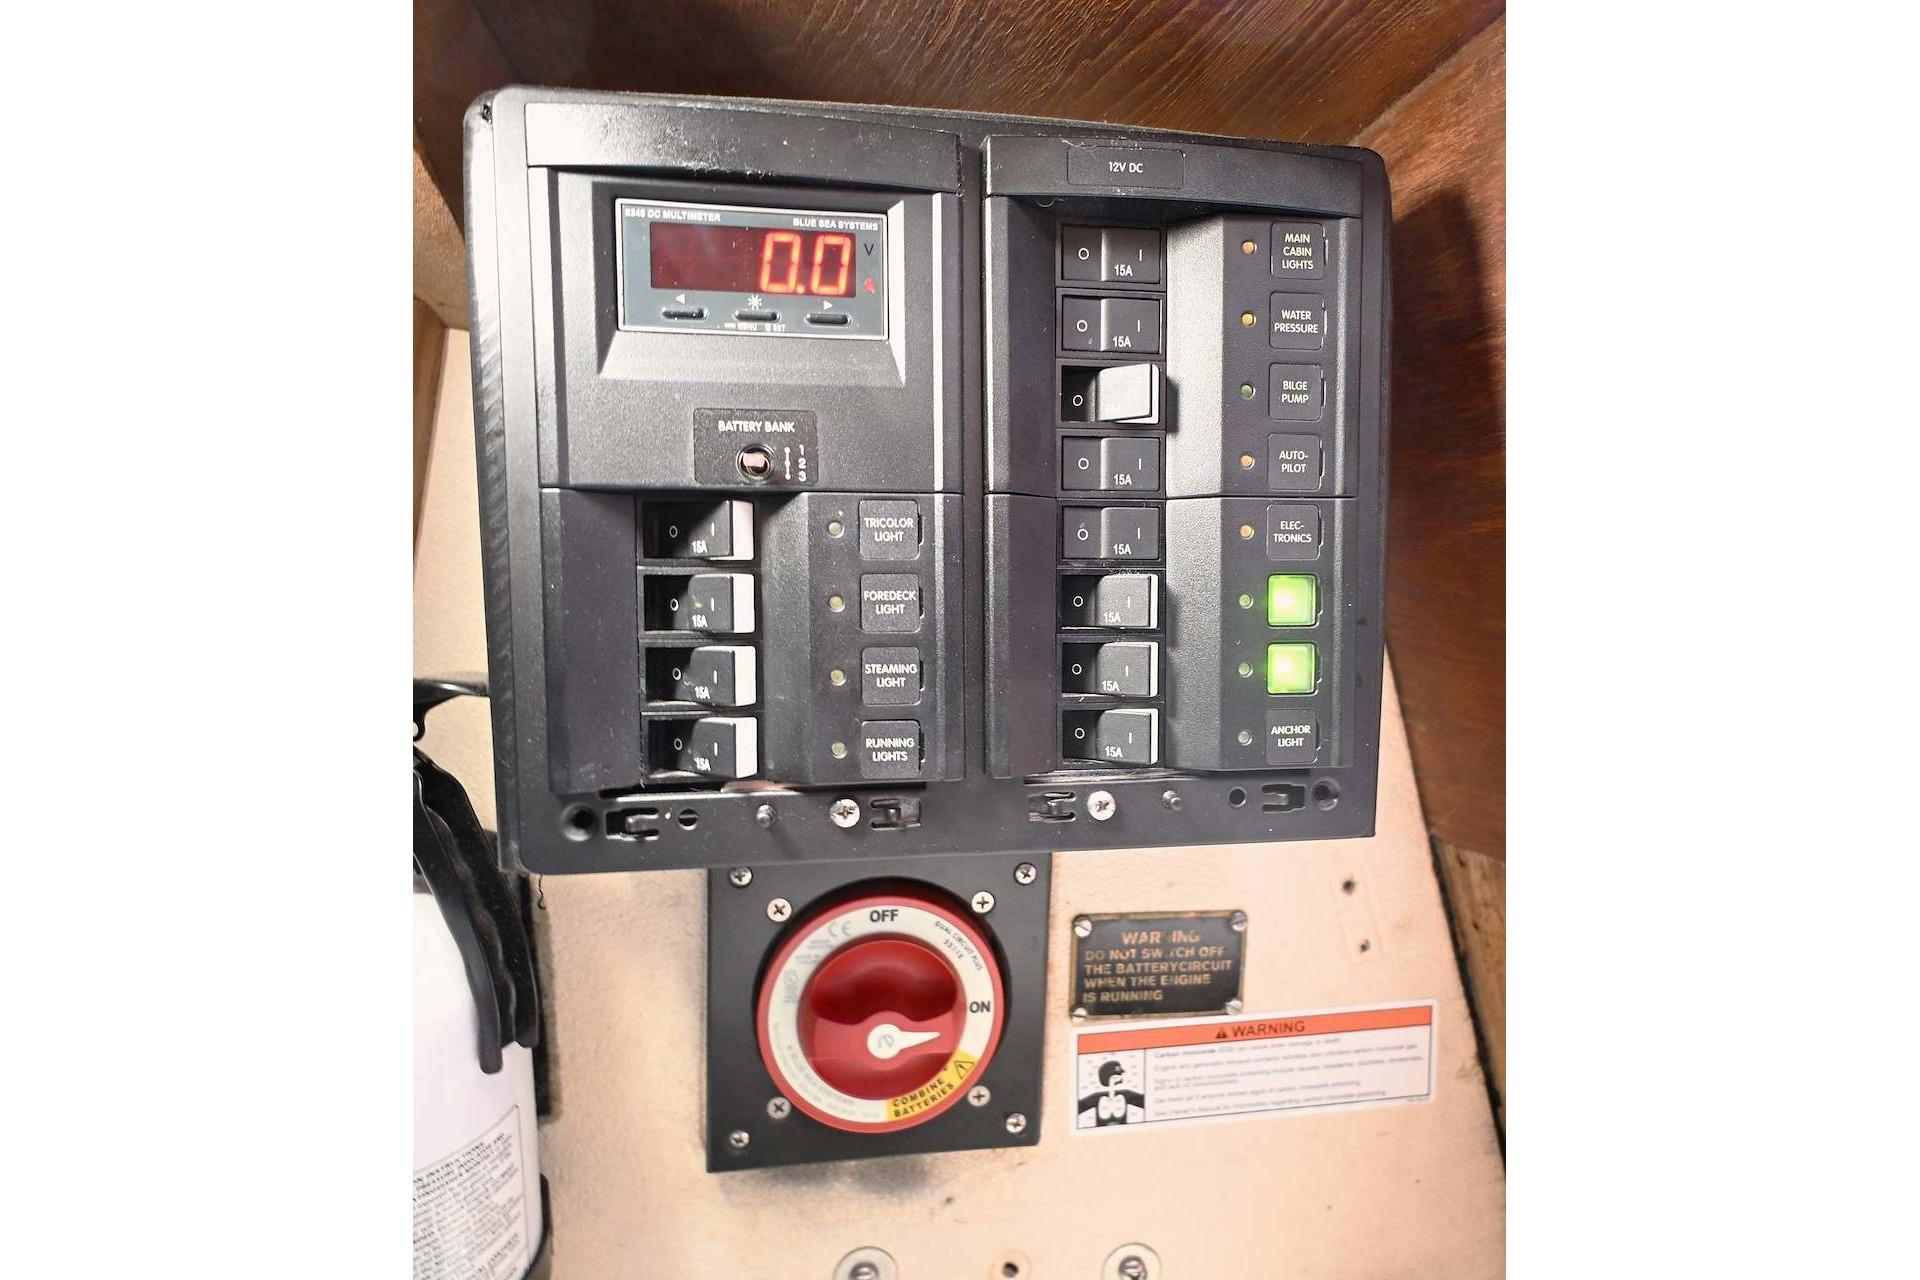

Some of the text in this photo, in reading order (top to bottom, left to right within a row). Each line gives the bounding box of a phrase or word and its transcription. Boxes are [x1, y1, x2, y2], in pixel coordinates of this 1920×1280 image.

[1108, 161, 1144, 173] 12V DC
[662, 209, 721, 223] MULTIMETER
[793, 218, 879, 231] BLUE SEA SYSTEMS
[1284, 232, 1311, 244] MAIN
[863, 243, 875, 256] V
[1282, 246, 1312, 257] CABIN
[759, 232, 852, 295] 0.0
[1281, 259, 1314, 270] LIGHTS
[1113, 264, 1134, 277] 15A
[1281, 309, 1312, 321] WATER
[1274, 322, 1319, 334] PRESSURE
[1111, 336, 1132, 348] 15A
[1282, 380, 1308, 391] BILGE
[1281, 393, 1309, 404] PUMP
[718, 420, 796, 433] BATTERY BANK
[798, 444, 805, 456] 1
[1279, 450, 1309, 462] AUTO-
[797, 457, 807, 469] 2
[1281, 463, 1307, 473] PILOT
[797, 471, 807, 482] 3
[1113, 474, 1133, 486] 15A
[863, 517, 914, 529] TRICOLOR
[1280, 520, 1305, 531] ELEC-
[874, 531, 905, 542] LIGHT
[1273, 533, 1312, 544] TRONICS
[691, 540, 708, 553] 15A
[1112, 544, 1132, 556] 15A
[863, 590, 916, 601] FOREDECK
[875, 604, 906, 615] LIGHT
[692, 615, 708, 627] 15A
[1103, 611, 1122, 623] 15A
[864, 663, 918, 675] STEAMING
[876, 677, 906, 688] LIGHT
[1101, 680, 1120, 692] 15A
[694, 686, 711, 700] 15A
[1270, 724, 1312, 736] ANCHOR
[865, 737, 915, 749] RUNNING
[1277, 737, 1305, 748] LIGHT
[872, 750, 908, 762] LIGHTS
[1104, 745, 1123, 758] 15A
[694, 757, 711, 771] 15A
[869, 908, 899, 923] OFF
[1121, 929, 1201, 945] WARING
[1084, 950, 1105, 961] DO
[1108, 948, 1137, 961] NOT
[1199, 945, 1225, 957] OFF
[1084, 963, 1112, 975] THE
[1084, 976, 1126, 989] WHEN
[1131, 975, 1156, 987] THE
[1082, 989, 1163, 1002] IS RUNNING
[969, 1001, 991, 1014] ON
[1232, 1020, 1306, 1038] WARNING
[892, 1077, 946, 1108] COMBINE
[893, 1082, 954, 1118] BATTERIES
